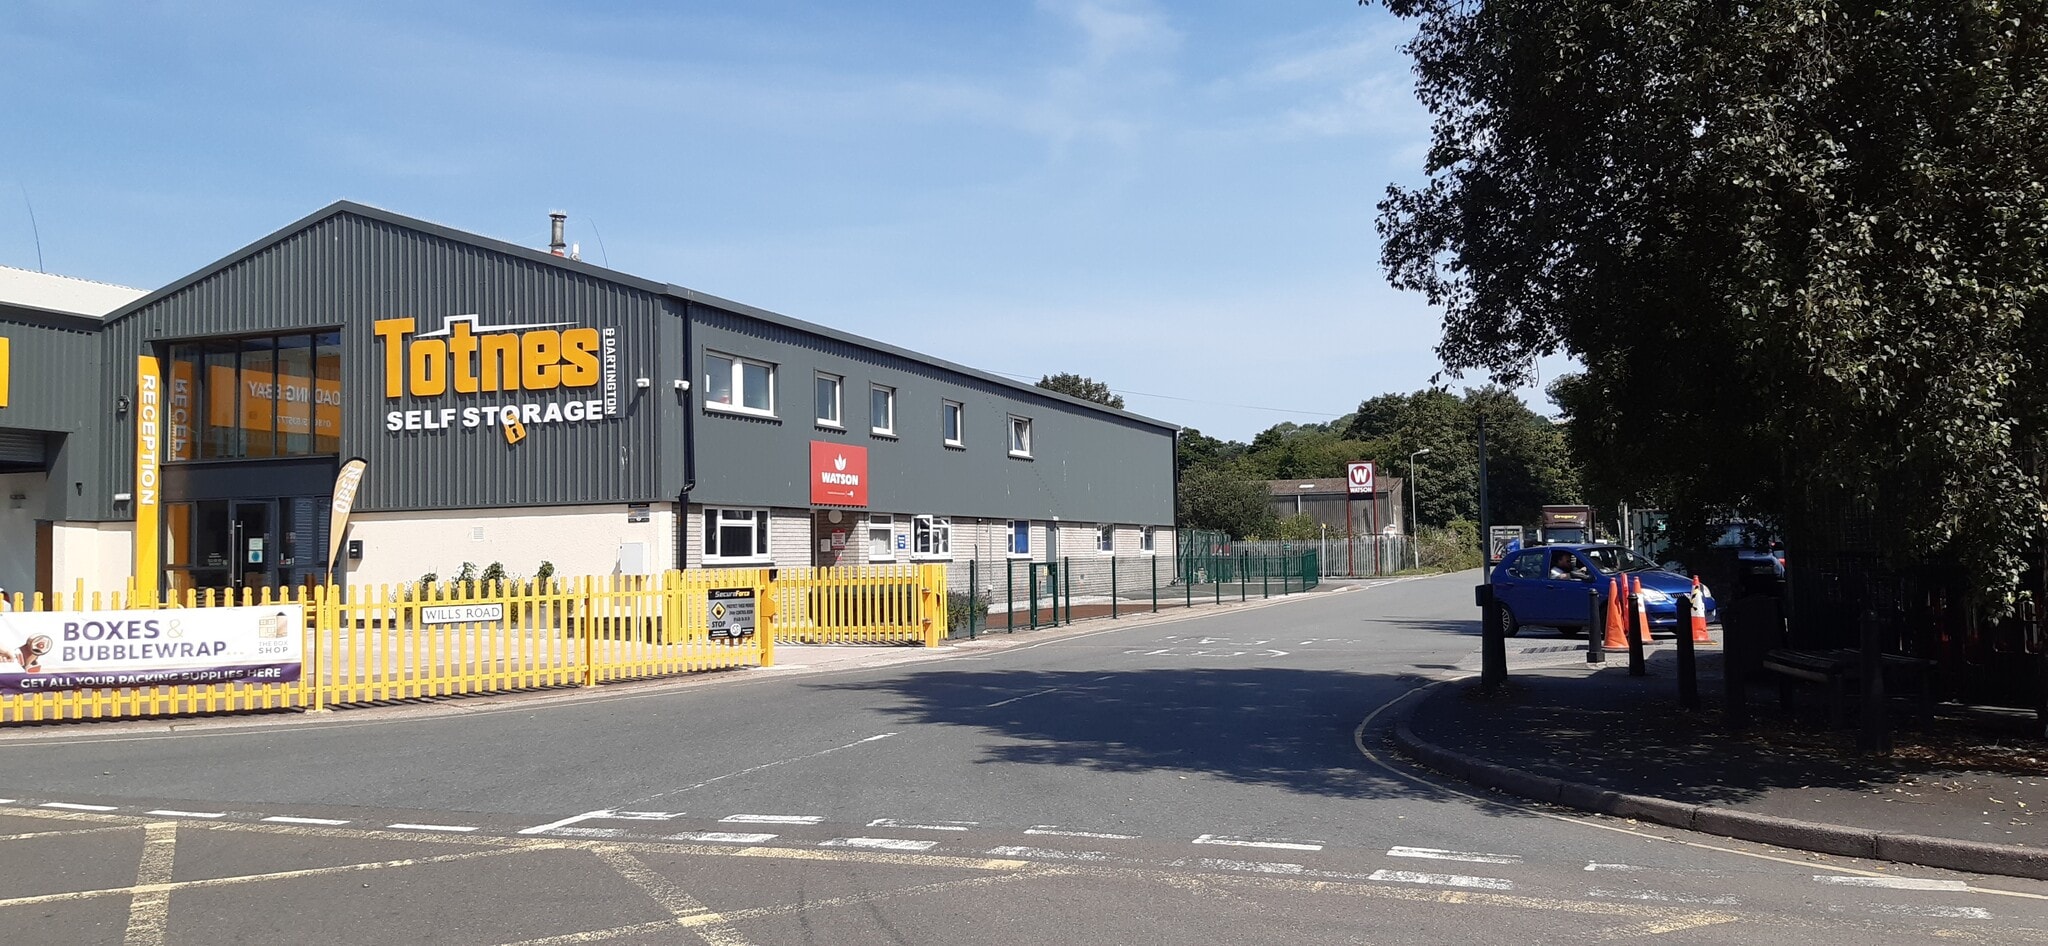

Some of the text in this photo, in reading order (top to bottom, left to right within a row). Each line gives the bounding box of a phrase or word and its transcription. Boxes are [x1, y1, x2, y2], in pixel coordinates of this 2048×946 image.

[374, 317, 600, 398] Totnes
[606, 328, 616, 414] & DARTINGTON
[386, 399, 604, 431] SELF STORAGE
[141, 374, 156, 505] RECEPTION
[821, 471, 859, 486] WATSON
[1353, 468, 1367, 483] W
[425, 607, 500, 620] WILLS ROAD
[63, 619, 184, 641] BOXES &
[20, 667, 281, 689] GET ALL YOUR PACKING SUPPLIES HERE
